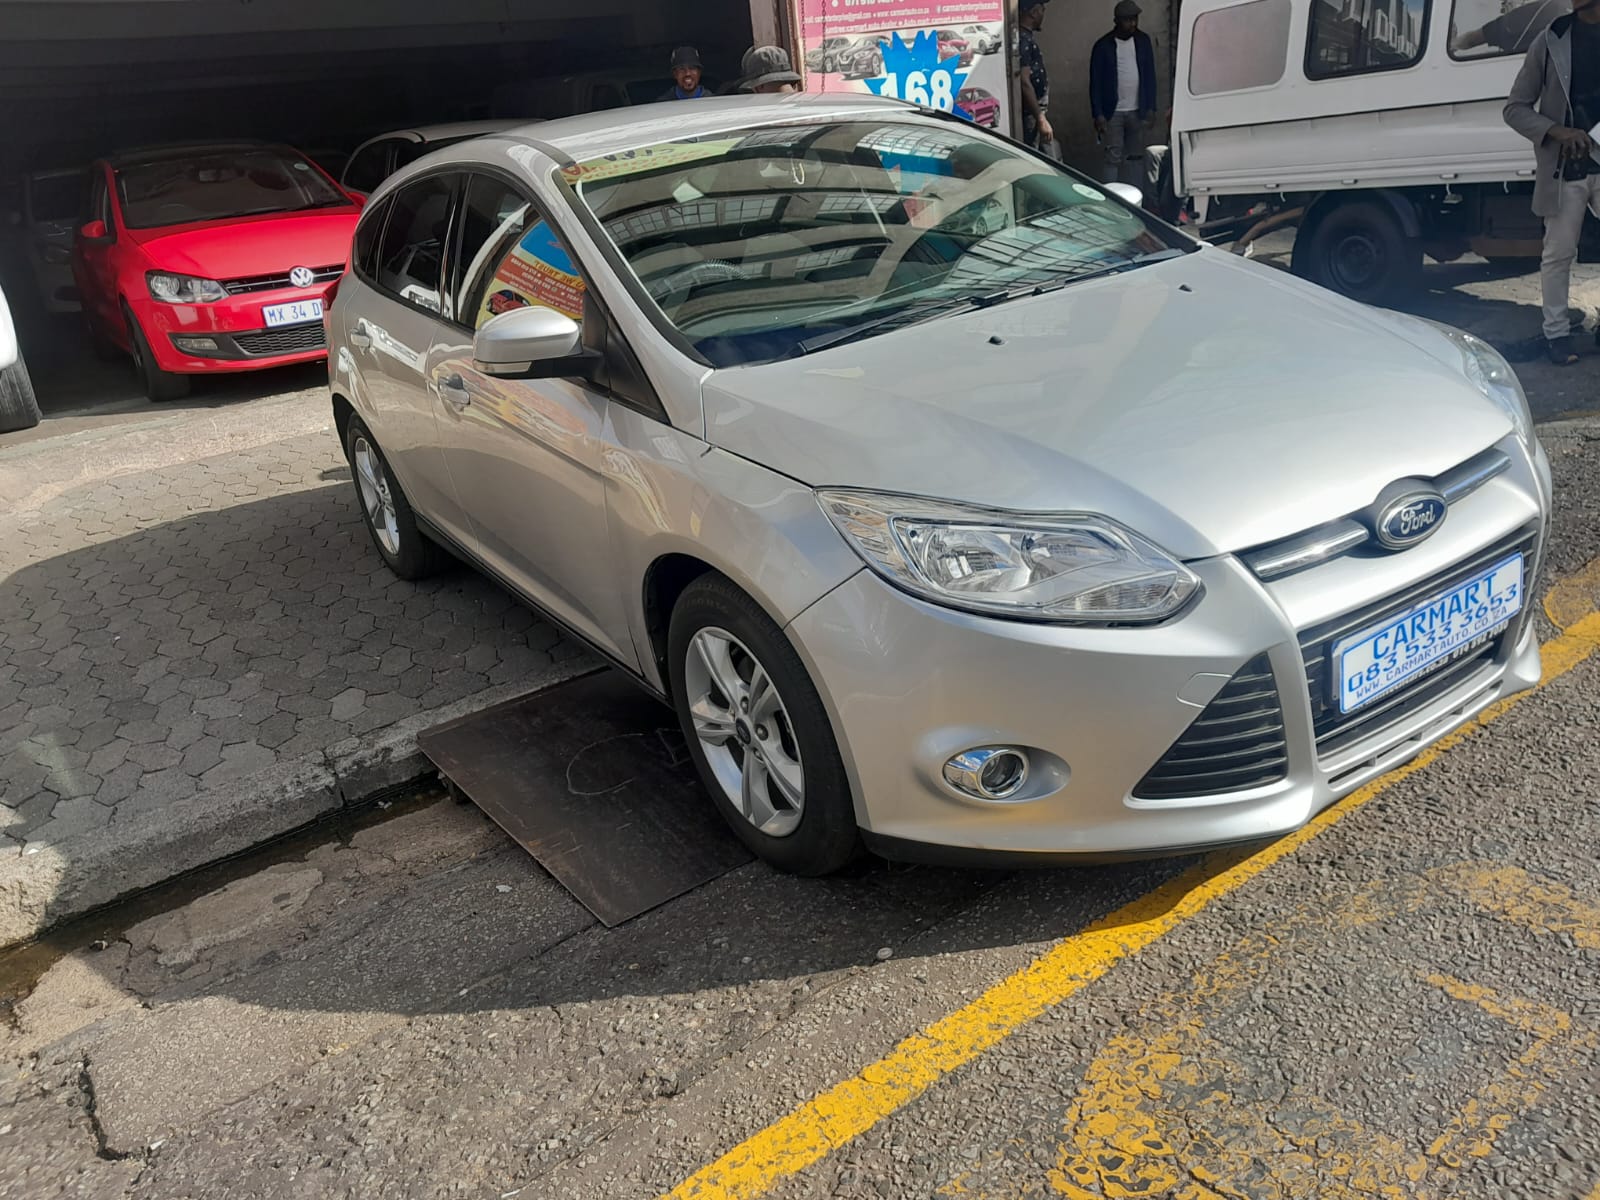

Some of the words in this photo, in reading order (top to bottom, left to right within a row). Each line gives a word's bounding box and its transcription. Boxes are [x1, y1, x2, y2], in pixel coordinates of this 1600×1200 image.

[268, 308, 285, 323] MX
[291, 304, 307, 320] 34
[312, 301, 323, 316] D
[1400, 502, 1436, 535] Ford
[1348, 651, 1397, 693] 083
[1405, 620, 1452, 660] 533
[1459, 582, 1517, 628] 3653
[1373, 572, 1497, 660] CARMART
